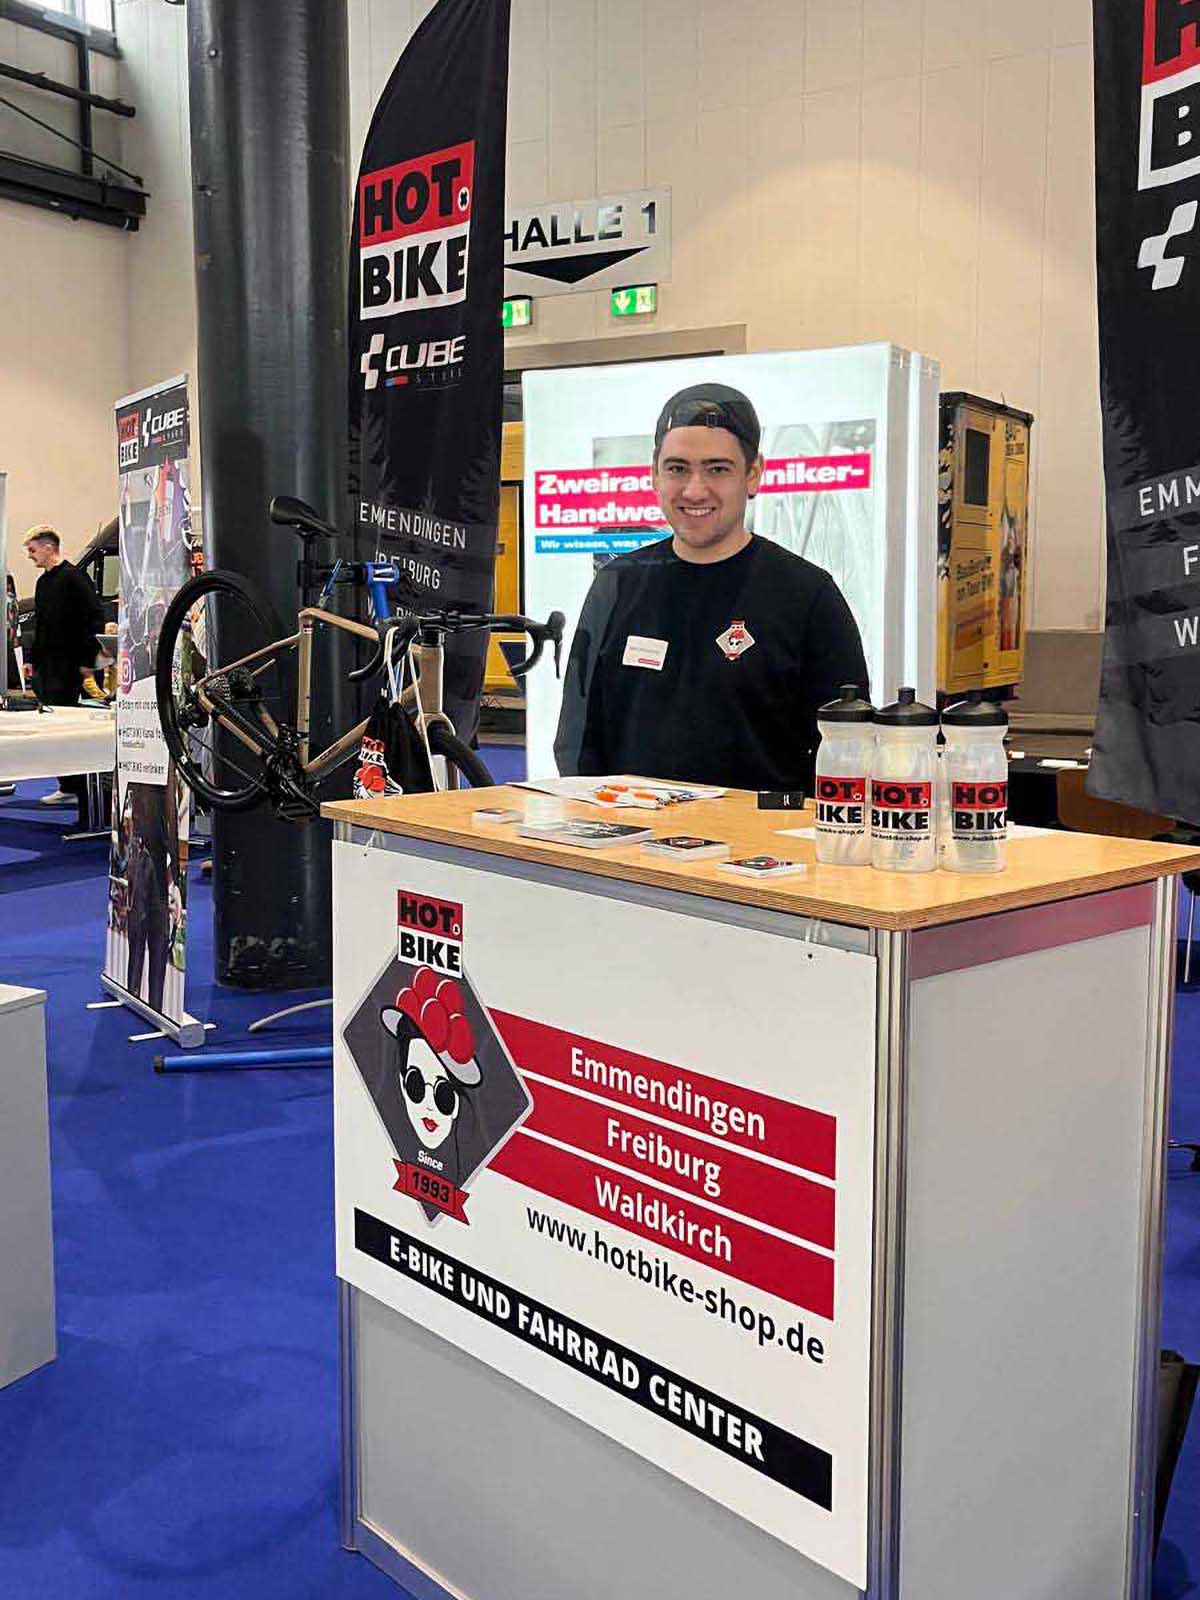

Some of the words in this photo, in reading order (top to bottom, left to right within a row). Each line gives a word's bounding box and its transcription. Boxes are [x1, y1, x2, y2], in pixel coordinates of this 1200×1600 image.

[641, 202, 656, 234] 1
[363, 234, 468, 308] BIKE
[386, 335, 466, 372] CUBE
[151, 407, 185, 435] CUBE
[816, 804, 862, 824] IKE
[400, 931, 460, 973] BIKE
[570, 1046, 766, 1141] Emmendingen
[417, 1150, 444, 1171] Since
[607, 1118, 722, 1197] Freiburg
[412, 1170, 449, 1203] 1993
[595, 1176, 733, 1262] Waldkirch
[527, 1205, 825, 1365] www.hotbike-shop.de
[389, 1234, 456, 1292] E-BIKE
[460, 1271, 512, 1320] UND
[518, 1303, 641, 1390] FAHRRAD
[649, 1374, 766, 1462] CENTER
